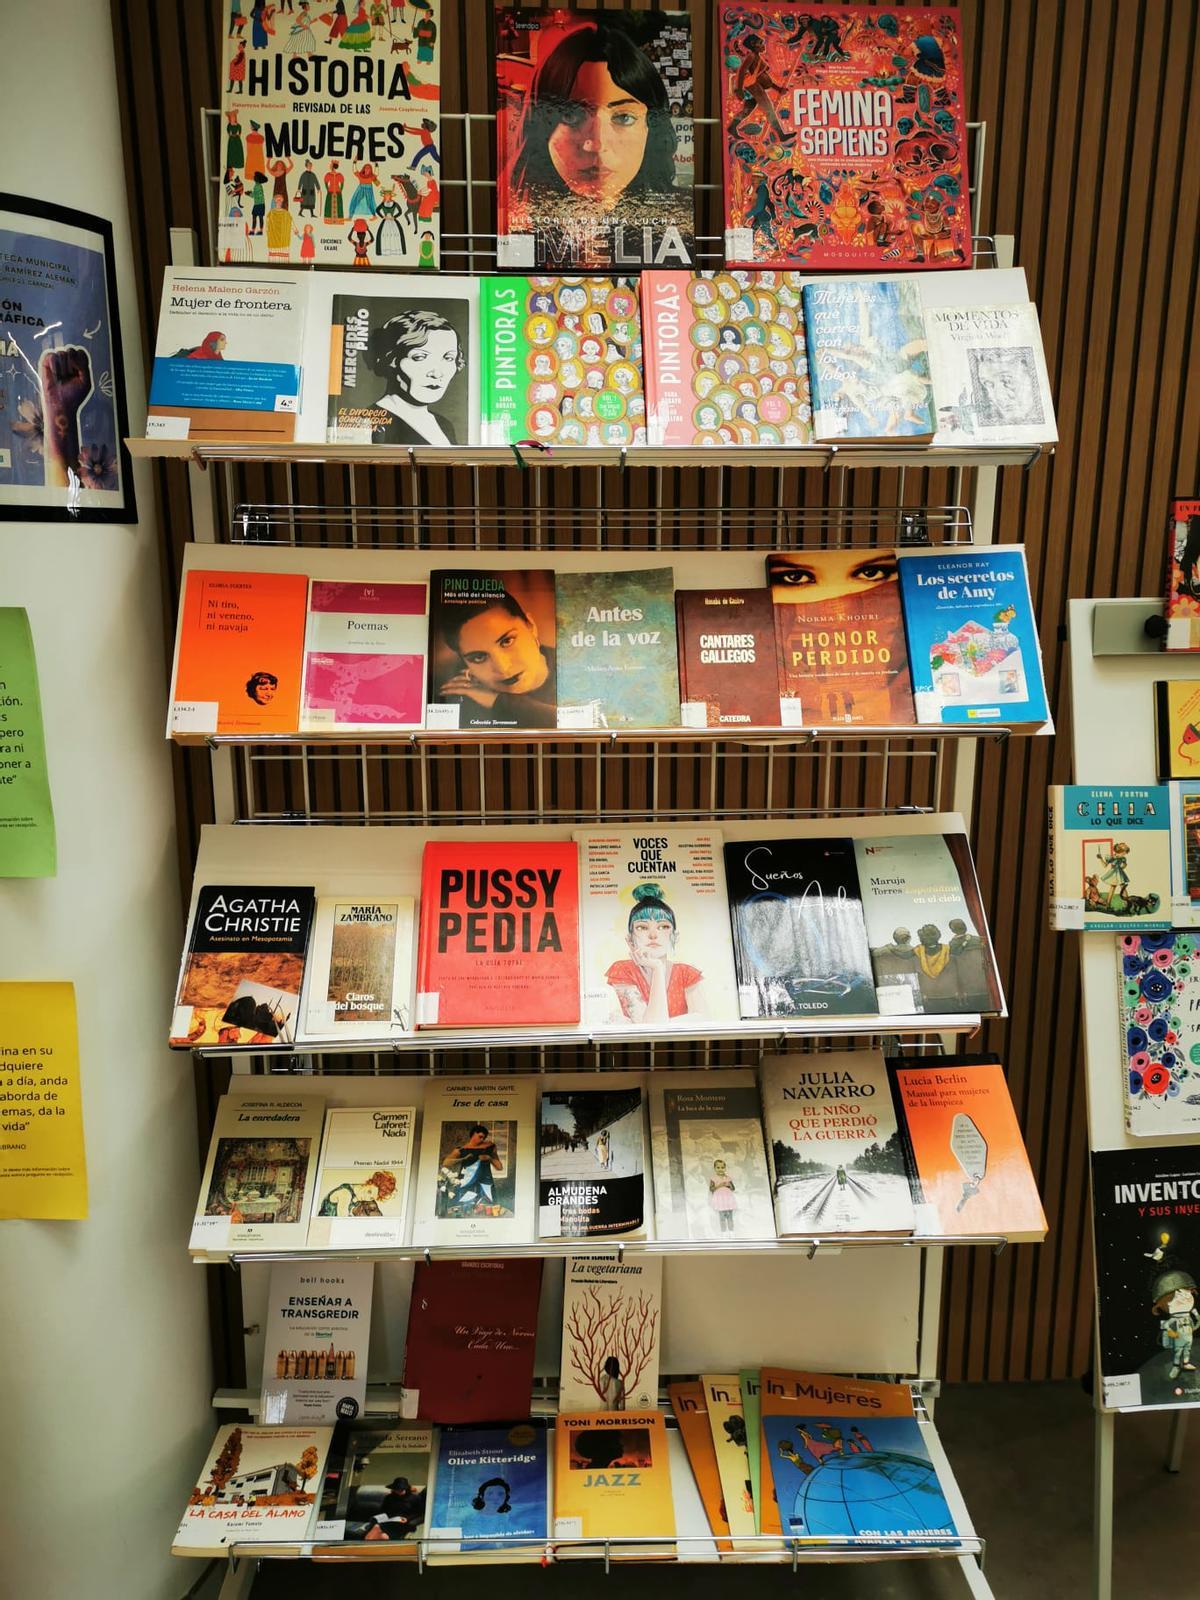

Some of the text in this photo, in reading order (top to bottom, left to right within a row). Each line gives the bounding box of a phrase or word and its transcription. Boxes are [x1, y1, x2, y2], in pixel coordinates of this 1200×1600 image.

[249, 53, 411, 100] HISTORIA
[293, 102, 371, 114] REVISADA DE LAS
[793, 88, 892, 127] FEMINA
[264, 119, 405, 162] MUJERES
[801, 128, 889, 156] SAPIENS
[512, 217, 677, 225] HISTORIA DE UNA LUCHA
[172, 284, 280, 295] Helena Maleno Garzón
[170, 296, 292, 311] Mujer de frontera
[812, 290, 877, 306] Mujeres
[814, 310, 840, 325] que
[935, 309, 1020, 322] MOMENTOS
[356, 308, 370, 351] PINTO
[949, 320, 1008, 332] DE VIDA
[492, 288, 519, 389] PINTORAS
[654, 283, 681, 384] PINTORAS
[817, 337, 843, 348] con
[343, 315, 358, 388] MERCEDES
[819, 351, 838, 364] los
[821, 368, 857, 382] lobos
[338, 407, 388, 418] EL DIVORCIO
[338, 416, 392, 426] COMO MEDIDA
[938, 562, 973, 570] ELEANOR
[916, 571, 1015, 586] Los secretos
[444, 579, 505, 592] PINO OJEDA
[938, 586, 997, 602] de Amy
[208, 600, 240, 610] Ni tiro,
[207, 612, 255, 622] ni veneno,
[587, 606, 644, 622] Antes
[798, 613, 879, 623] NORMA KHOURI
[206, 622, 249, 633] ni navaja
[347, 620, 389, 631] Poemas
[571, 631, 661, 648] de la voz
[700, 634, 755, 648] CANTARES
[801, 630, 878, 648] HONOR
[701, 649, 756, 663] GALLEGOS
[792, 648, 891, 666] PERDIDO
[1077, 801, 1156, 816] CELIA
[1091, 817, 1144, 826] LO QUE DICE
[633, 838, 668, 849] VOCES
[640, 850, 662, 861] QUE
[628, 861, 677, 873] CUENTAN
[870, 877, 906, 887] Maruja
[440, 869, 562, 909] PUSSY
[209, 895, 300, 914] AGATHA
[913, 894, 961, 904] en el cielo
[350, 905, 382, 915] MARÍA
[204, 914, 301, 933] CHRISTIE
[340, 914, 393, 922] ZAMBRANO
[438, 912, 563, 953] PEDIA
[251, 936, 293, 944] Mesopotamia
[346, 993, 375, 1001] Claros
[335, 1002, 385, 1012] del bosque
[22, 1048, 36, 1056] en
[40, 1047, 53, 1056] su
[7, 1076, 68, 1087] a día, anda
[799, 1071, 854, 1085] JULIA
[936, 1074, 968, 1084] Berlin
[44, 1091, 58, 1101] de
[783, 1084, 876, 1100] NAVARRO
[906, 1087, 990, 1099] Manual para mujeres
[453, 1098, 472, 1107] Irse
[474, 1099, 486, 1107] de
[696, 1094, 726, 1102] Montero
[930, 1099, 964, 1108] limpieza
[38, 1106, 53, 1116] da
[56, 1106, 66, 1115] la
[803, 1103, 861, 1116] EL NIÑO
[238, 1113, 300, 1122] La enredadera
[373, 1112, 409, 1121] Carmen
[375, 1121, 410, 1130] Laforet:
[789, 1116, 878, 1130] QUE PERDIÓ
[382, 1129, 407, 1138] Nada
[793, 1128, 878, 1142] LA GUERRA
[548, 1186, 608, 1197] ALMUDENA
[548, 1195, 599, 1206] GRANDES
[562, 1207, 600, 1215] tres bodas
[1138, 1207, 1146, 1217] Y
[1149, 1206, 1171, 1217] SUS
[571, 1263, 643, 1276] La vegetariana
[288, 1295, 353, 1306] ENSEÑAR A
[280, 1309, 360, 1319] TRANSGREDIR
[596, 1418, 656, 1426] MORRISON
[447, 1454, 537, 1466] Olive Kitteridge
[583, 1474, 642, 1488] JAZZ
[189, 1509, 206, 1518] LA
[208, 1510, 239, 1520] CASA
[240, 1508, 263, 1518] DEL
[858, 1528, 953, 1537] CON LAS MUJERES
